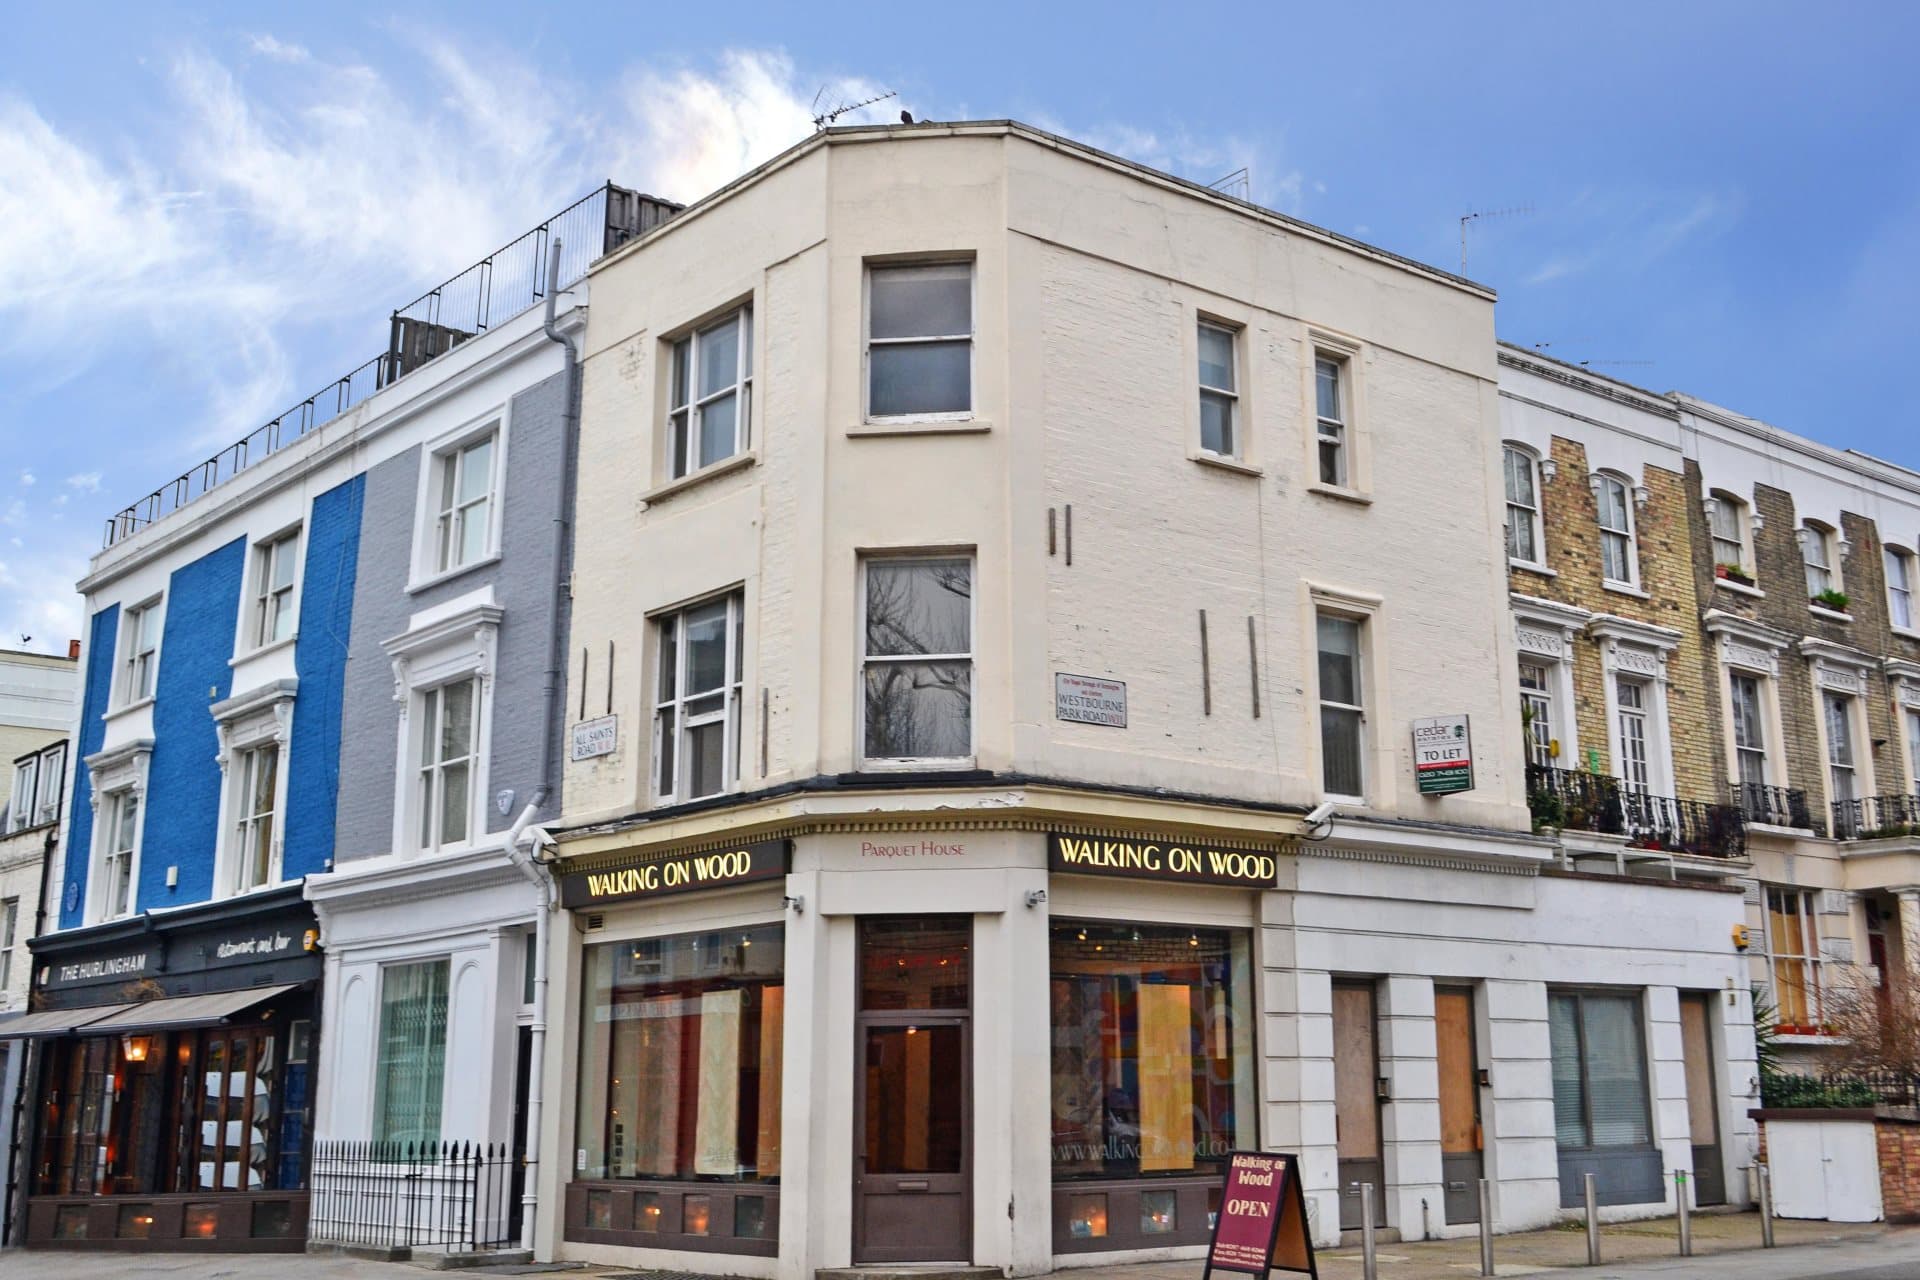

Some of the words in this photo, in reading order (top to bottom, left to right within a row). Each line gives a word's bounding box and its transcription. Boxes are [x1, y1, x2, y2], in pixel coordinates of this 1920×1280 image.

[1058, 693, 1124, 713] WESTBOURNE
[1058, 706, 1081, 720] PARK
[1082, 709, 1107, 722] ROAD
[1415, 720, 1451, 737] cedar
[576, 743, 596, 756] ROAD
[1423, 750, 1440, 761] TO
[1442, 748, 1463, 760] LET
[1058, 837, 1161, 871] WALKING
[1167, 847, 1202, 873] ON
[1207, 851, 1276, 880] WOOD
[587, 865, 659, 897] WALKING
[663, 860, 690, 887] ON
[693, 851, 751, 881] WOOD
[60, 964, 78, 982] THE
[78, 954, 146, 980] HURLINGHAM
[1232, 1155, 1273, 1171] Walking
[1238, 1170, 1274, 1187] Wood
[1227, 1198, 1271, 1218] OPEN
